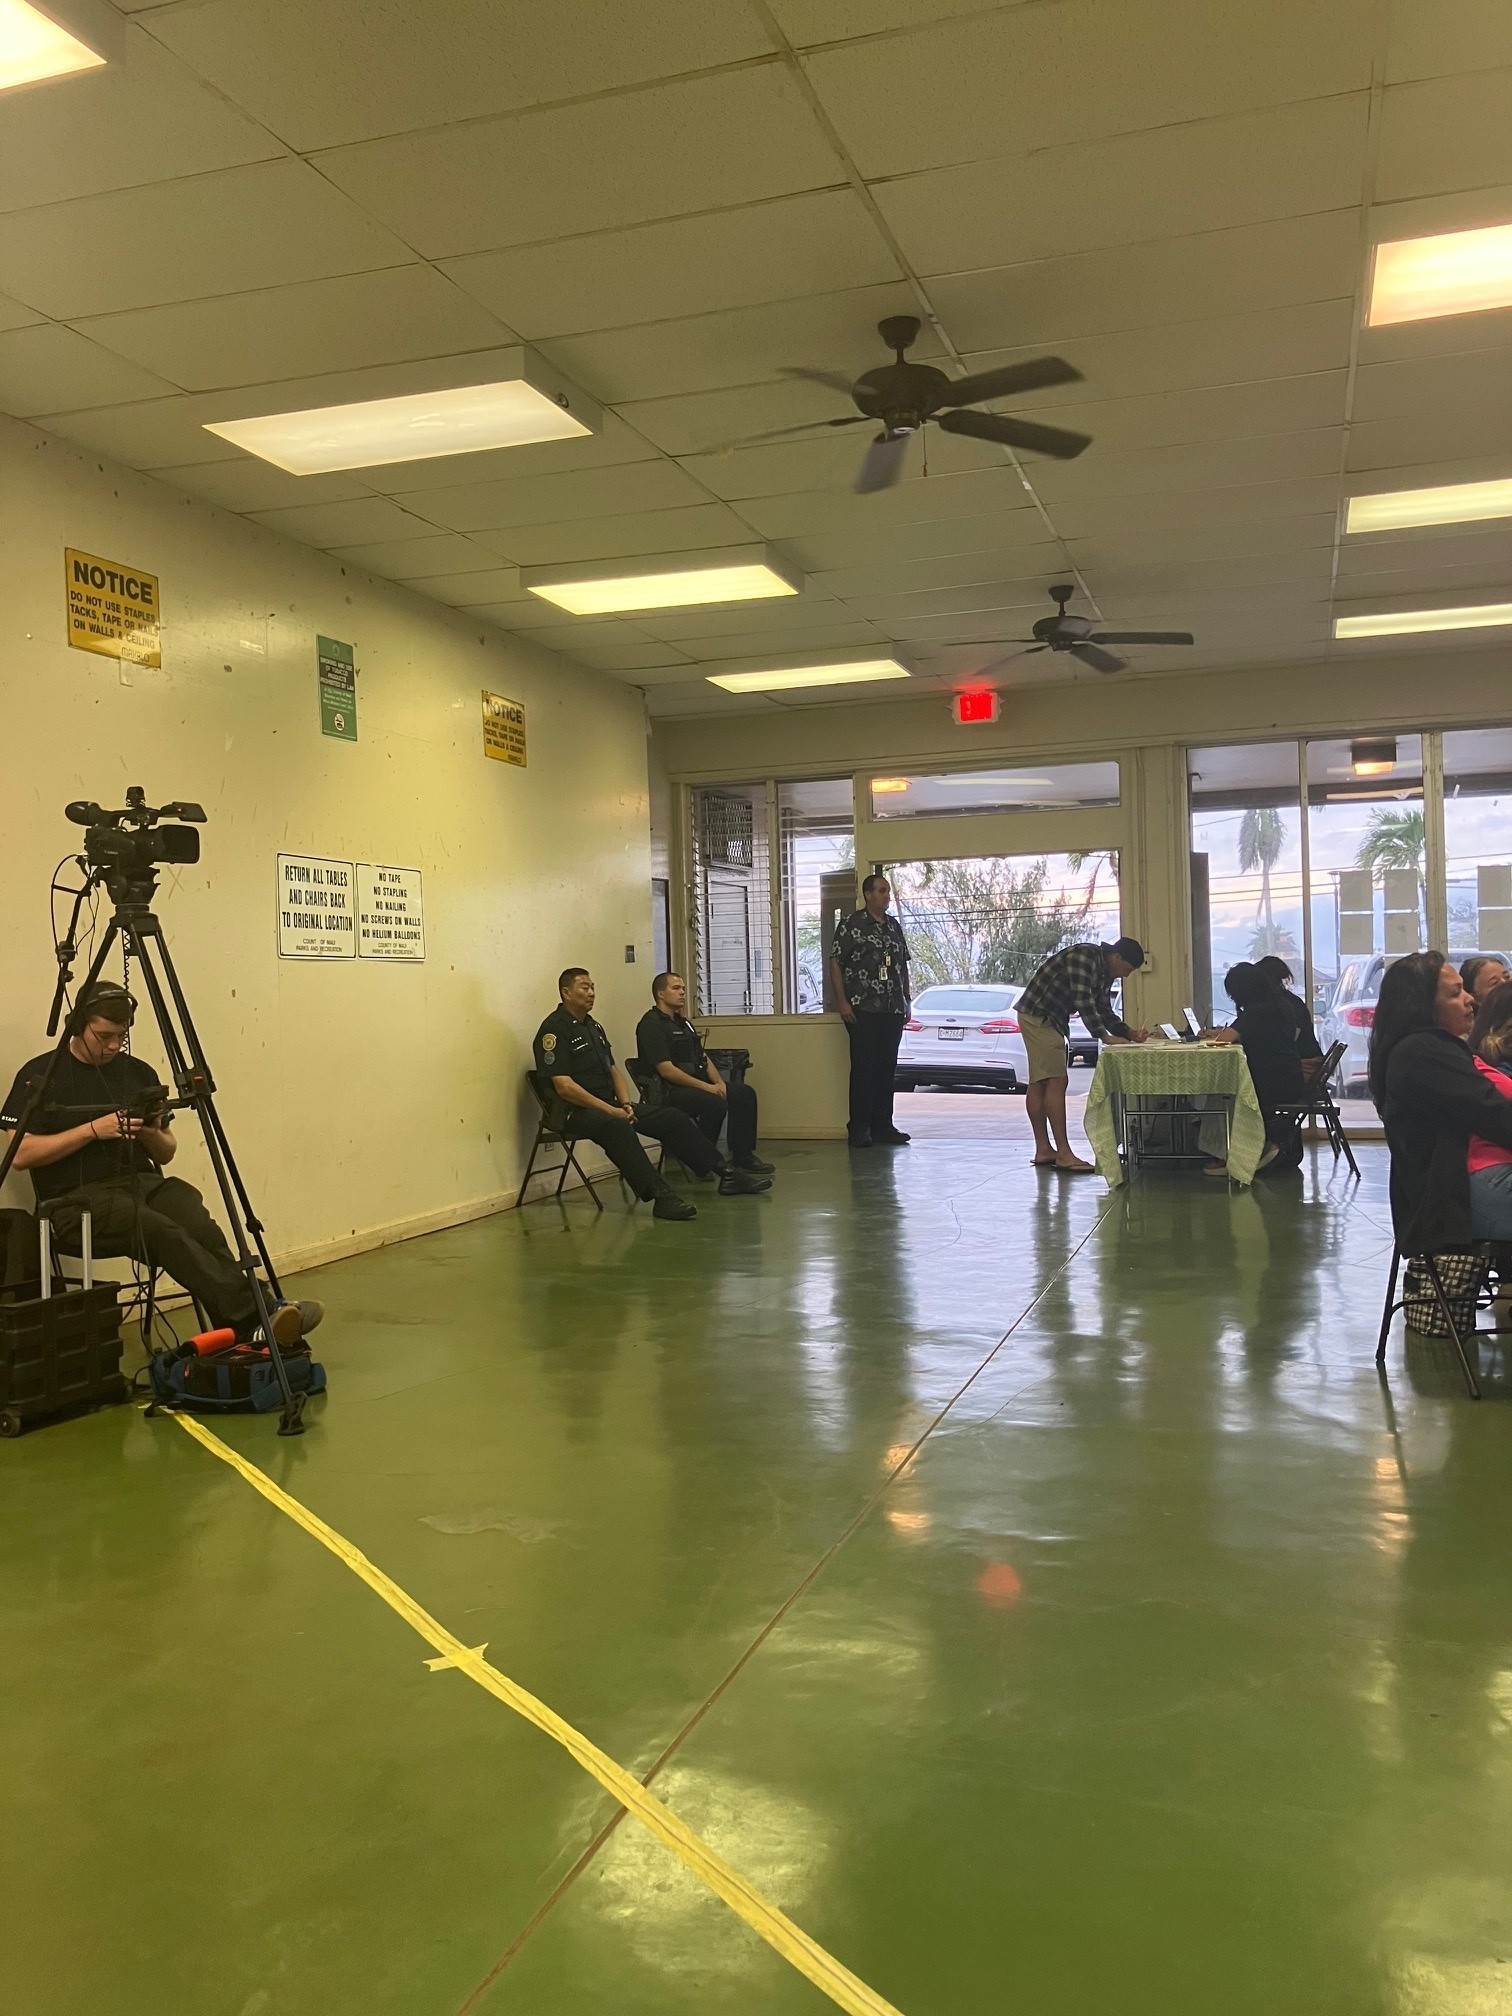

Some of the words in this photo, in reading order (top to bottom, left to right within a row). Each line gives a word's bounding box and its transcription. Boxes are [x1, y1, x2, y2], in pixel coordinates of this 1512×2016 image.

[74, 560, 153, 605] NOTICE
[70, 590, 82, 602] DO
[86, 595, 102, 608] NOT
[105, 601, 121, 613] USE
[70, 603, 99, 622] TACKS,
[102, 613, 121, 626] TAPE
[125, 620, 135, 630] OR
[74, 619, 85, 630] ON
[89, 622, 114, 638] WALLS
[118, 631, 122, 640] &
[126, 634, 154, 649] CEILING
[485, 698, 523, 725] NOTICE
[285, 865, 311, 883] RETURN
[313, 868, 324, 884] ALL
[326, 870, 348, 887] TABLES
[378, 873, 387, 882] NO
[388, 874, 401, 883] TAPE
[289, 889, 302, 905] AND
[305, 890, 328, 907] CHAIRS
[330, 892, 346, 908] BACK
[373, 886, 381, 895] NO
[383, 887, 407, 898] STAPLING
[375, 901, 383, 910] NO
[385, 901, 406, 912] NAILING
[282, 911, 290, 928] TO
[293, 912, 323, 930] ORIGINAL
[325, 914, 353, 931] LOCATION
[361, 914, 369, 923] NO
[371, 915, 393, 925] SCREWS
[395, 916, 402, 925] ON
[404, 917, 421, 927] WALLS
[362, 929, 370, 938] NO
[372, 929, 392, 939] HELIUM
[394, 930, 421, 940] BALLOONS
